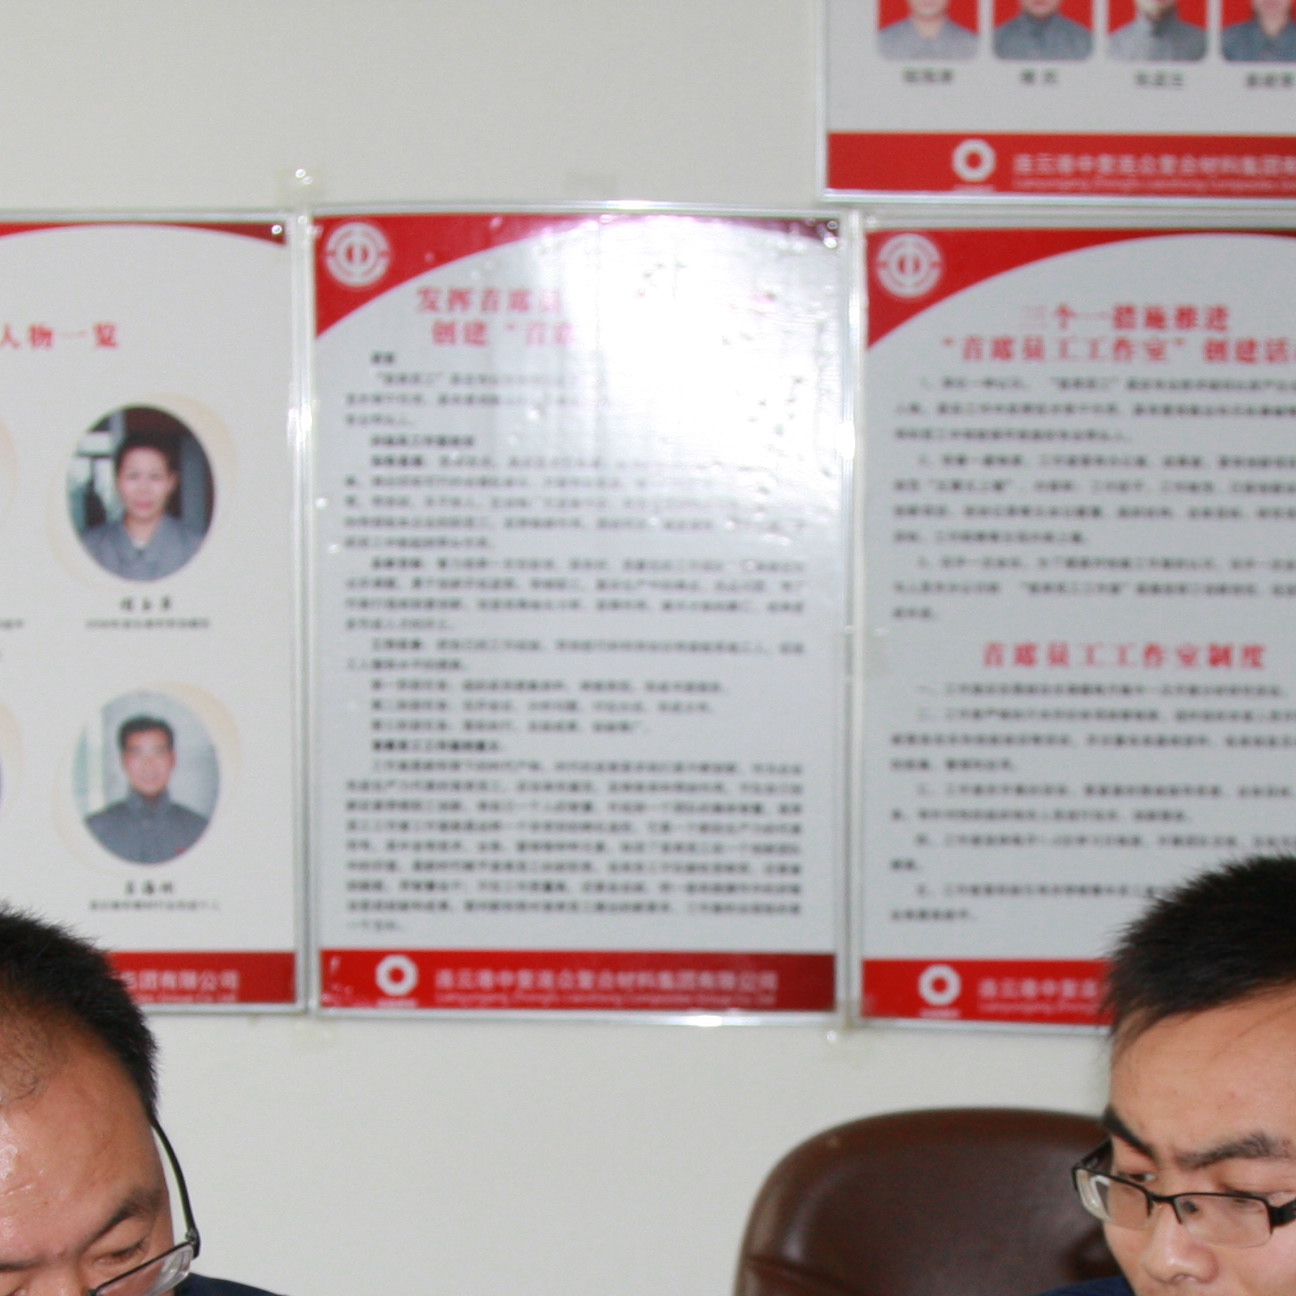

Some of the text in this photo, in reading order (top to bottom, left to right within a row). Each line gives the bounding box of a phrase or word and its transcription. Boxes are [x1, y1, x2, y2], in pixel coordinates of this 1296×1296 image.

[1021, 304, 1231, 333] 三个一措施推进
[982, 642, 1267, 669] 首席员工工作室制度
